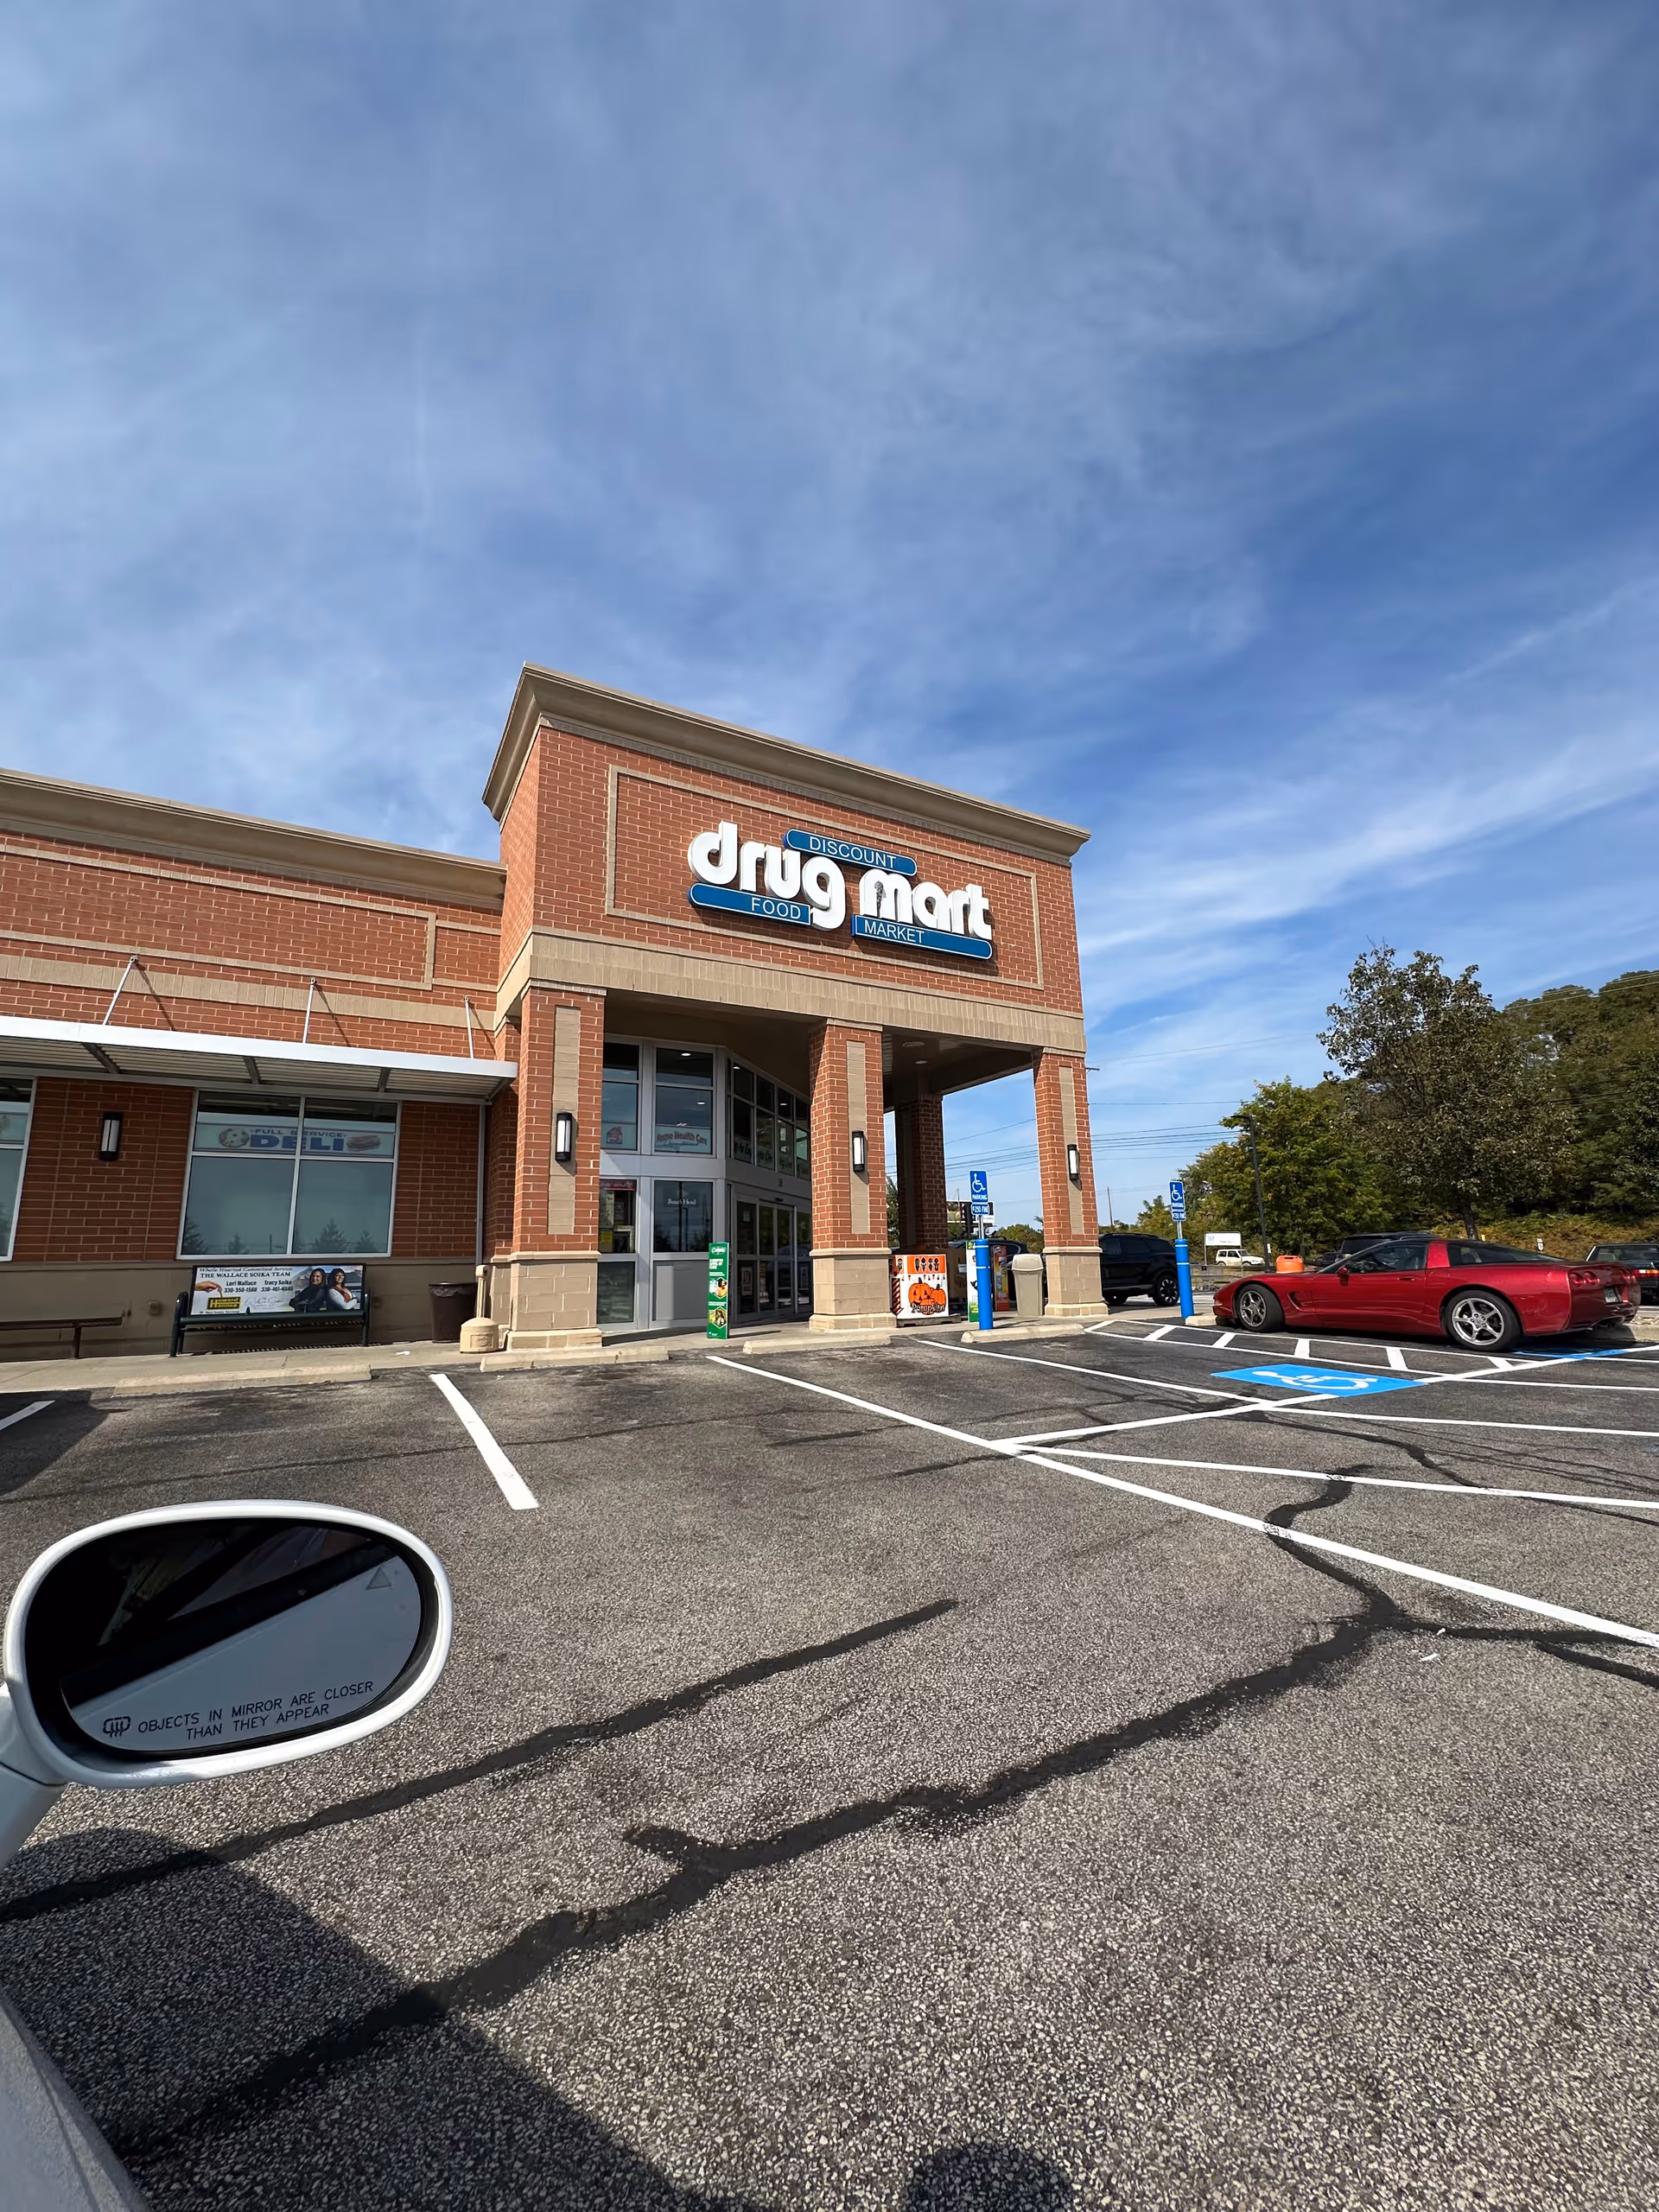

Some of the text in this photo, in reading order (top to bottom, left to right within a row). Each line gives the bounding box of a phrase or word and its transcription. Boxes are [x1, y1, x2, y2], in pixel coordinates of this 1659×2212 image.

[809, 836, 897, 869] DISCOUNT
[687, 820, 992, 940] drug mart
[751, 898, 801, 920] FOOD
[865, 920, 925, 944] MARKET
[250, 1135, 344, 1151] DELI
[138, 1681, 373, 1734] OBJECTS IN MIRROR ARE CLOSER
[187, 1703, 328, 1740] THAN THEY APPEAR
